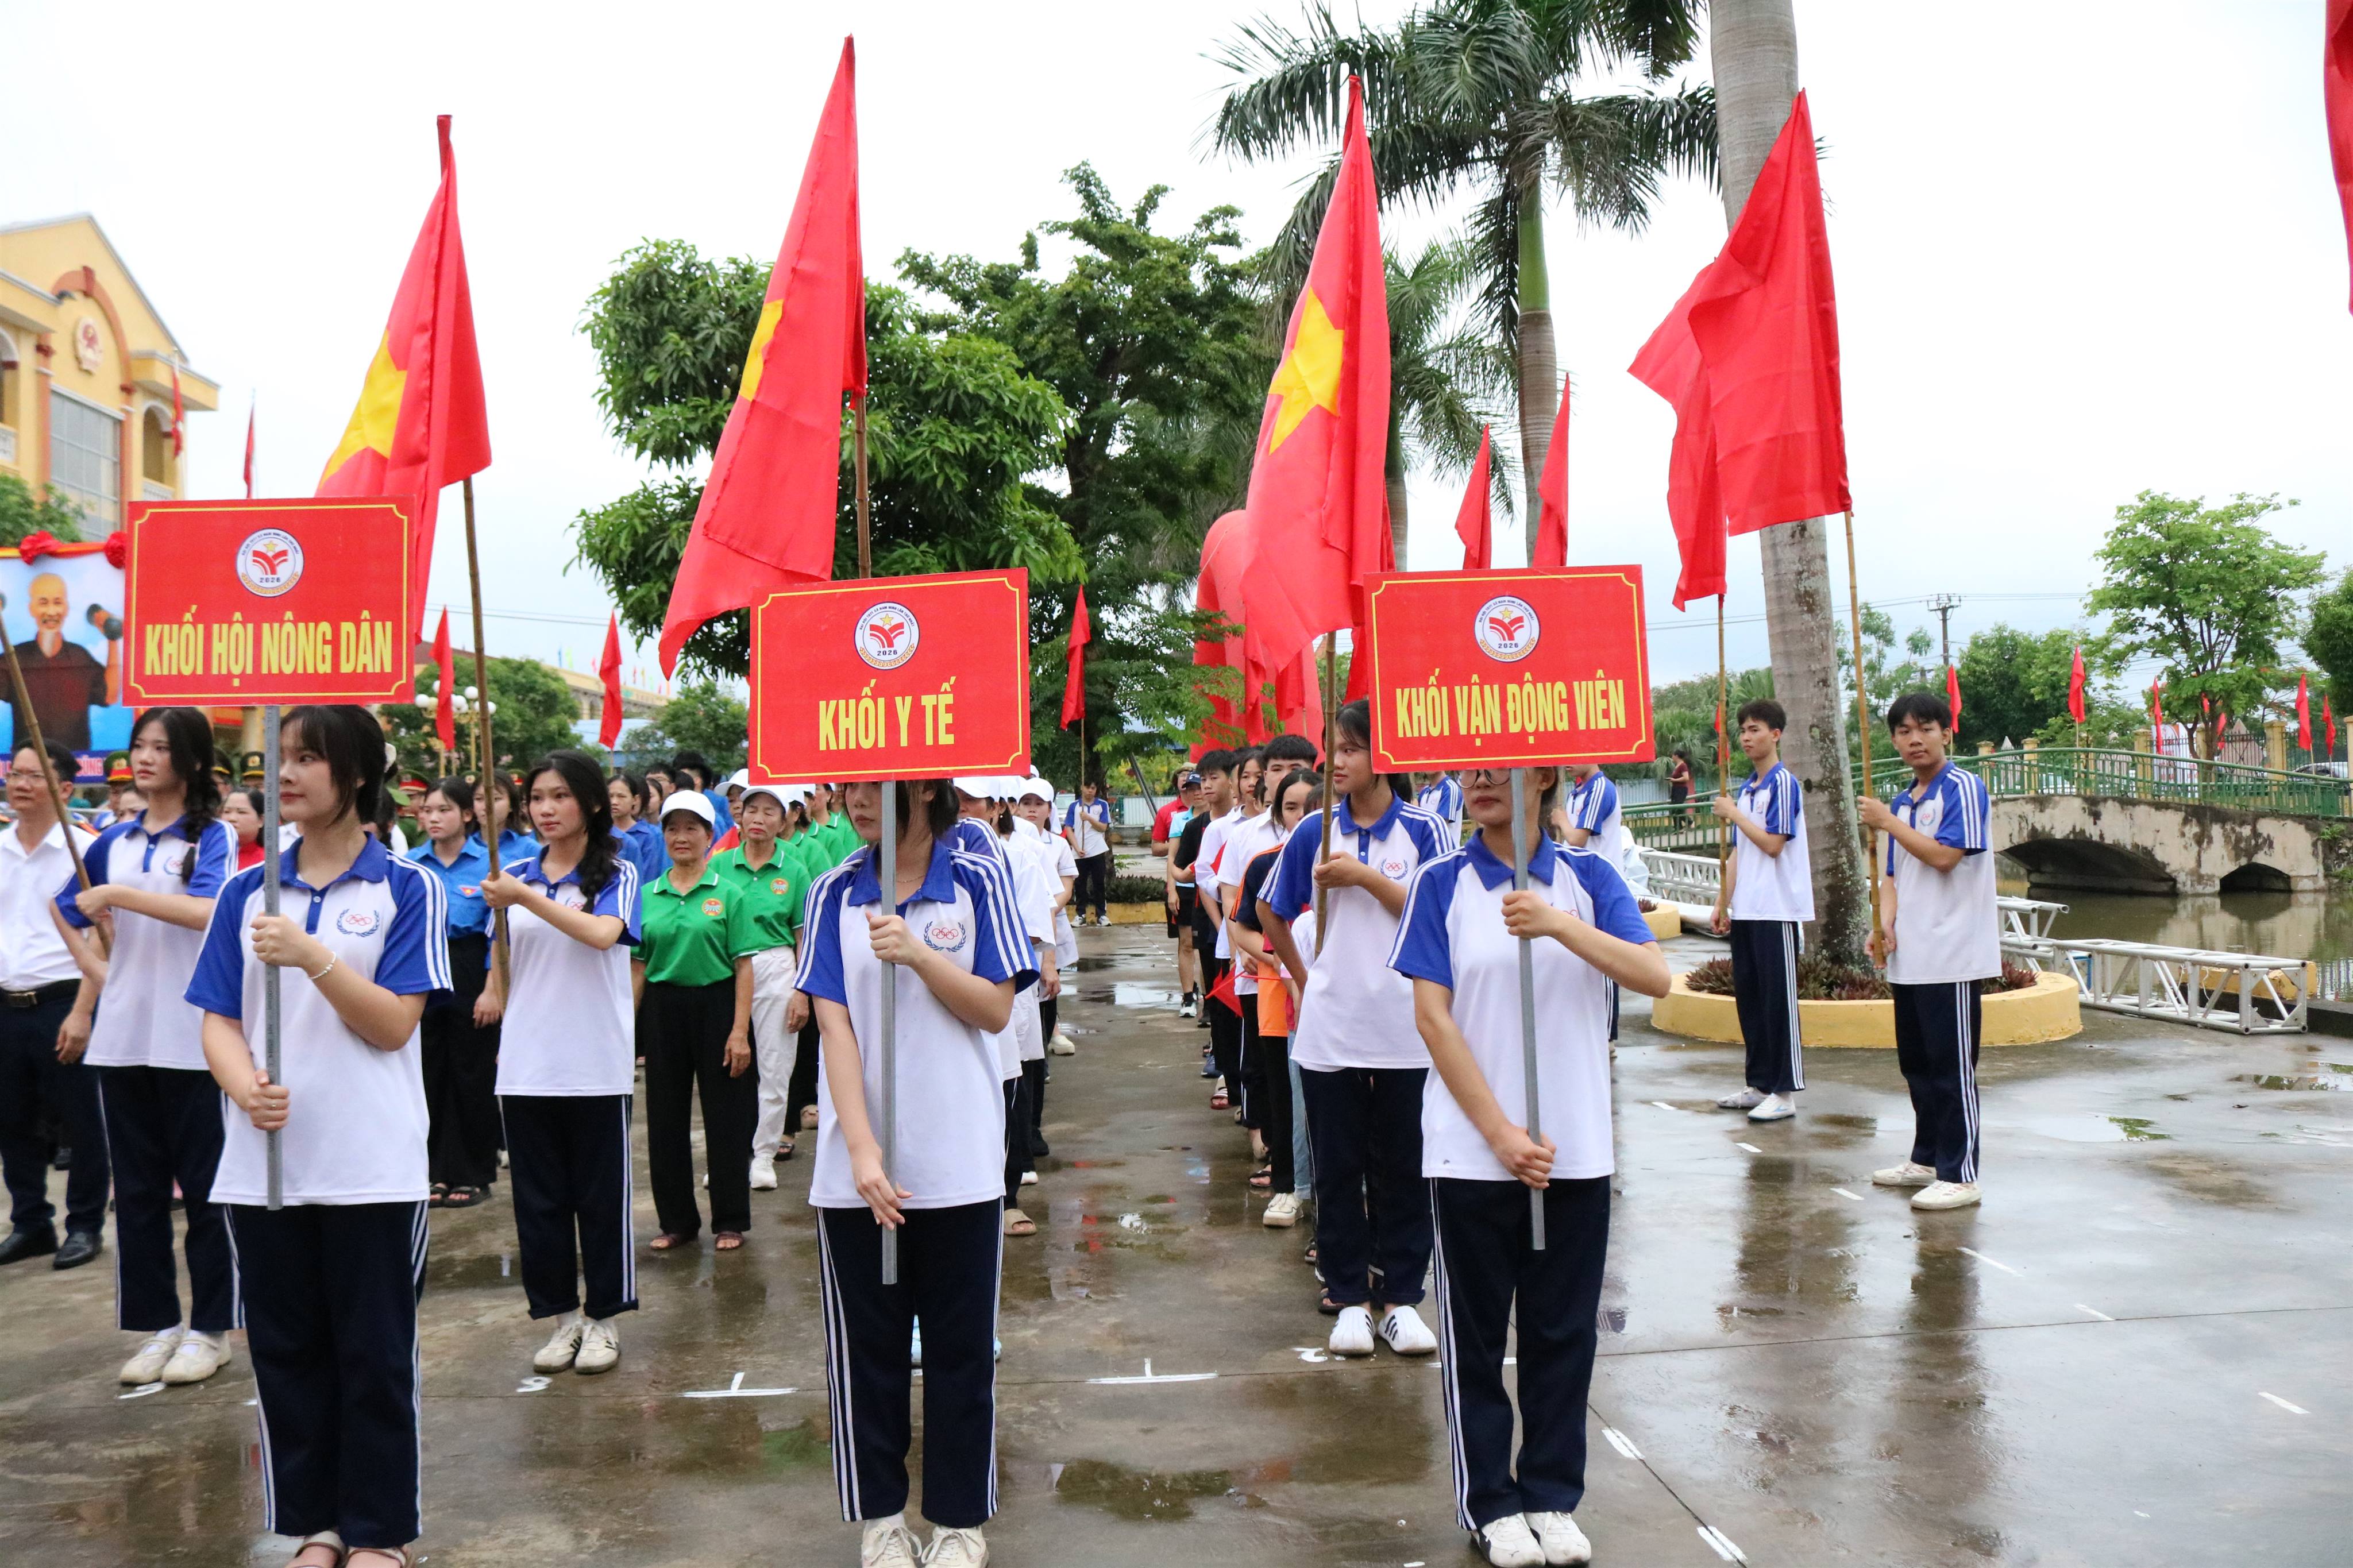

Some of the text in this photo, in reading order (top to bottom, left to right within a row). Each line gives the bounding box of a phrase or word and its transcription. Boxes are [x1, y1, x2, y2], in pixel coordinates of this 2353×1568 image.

[145, 604, 392, 687] KHỐI HỘI NÔNG DÂN
[819, 676, 956, 751] KHỐI Y TẾ
[1396, 668, 1626, 746] KHỐI VẬN ĐỘNG VIÊN
